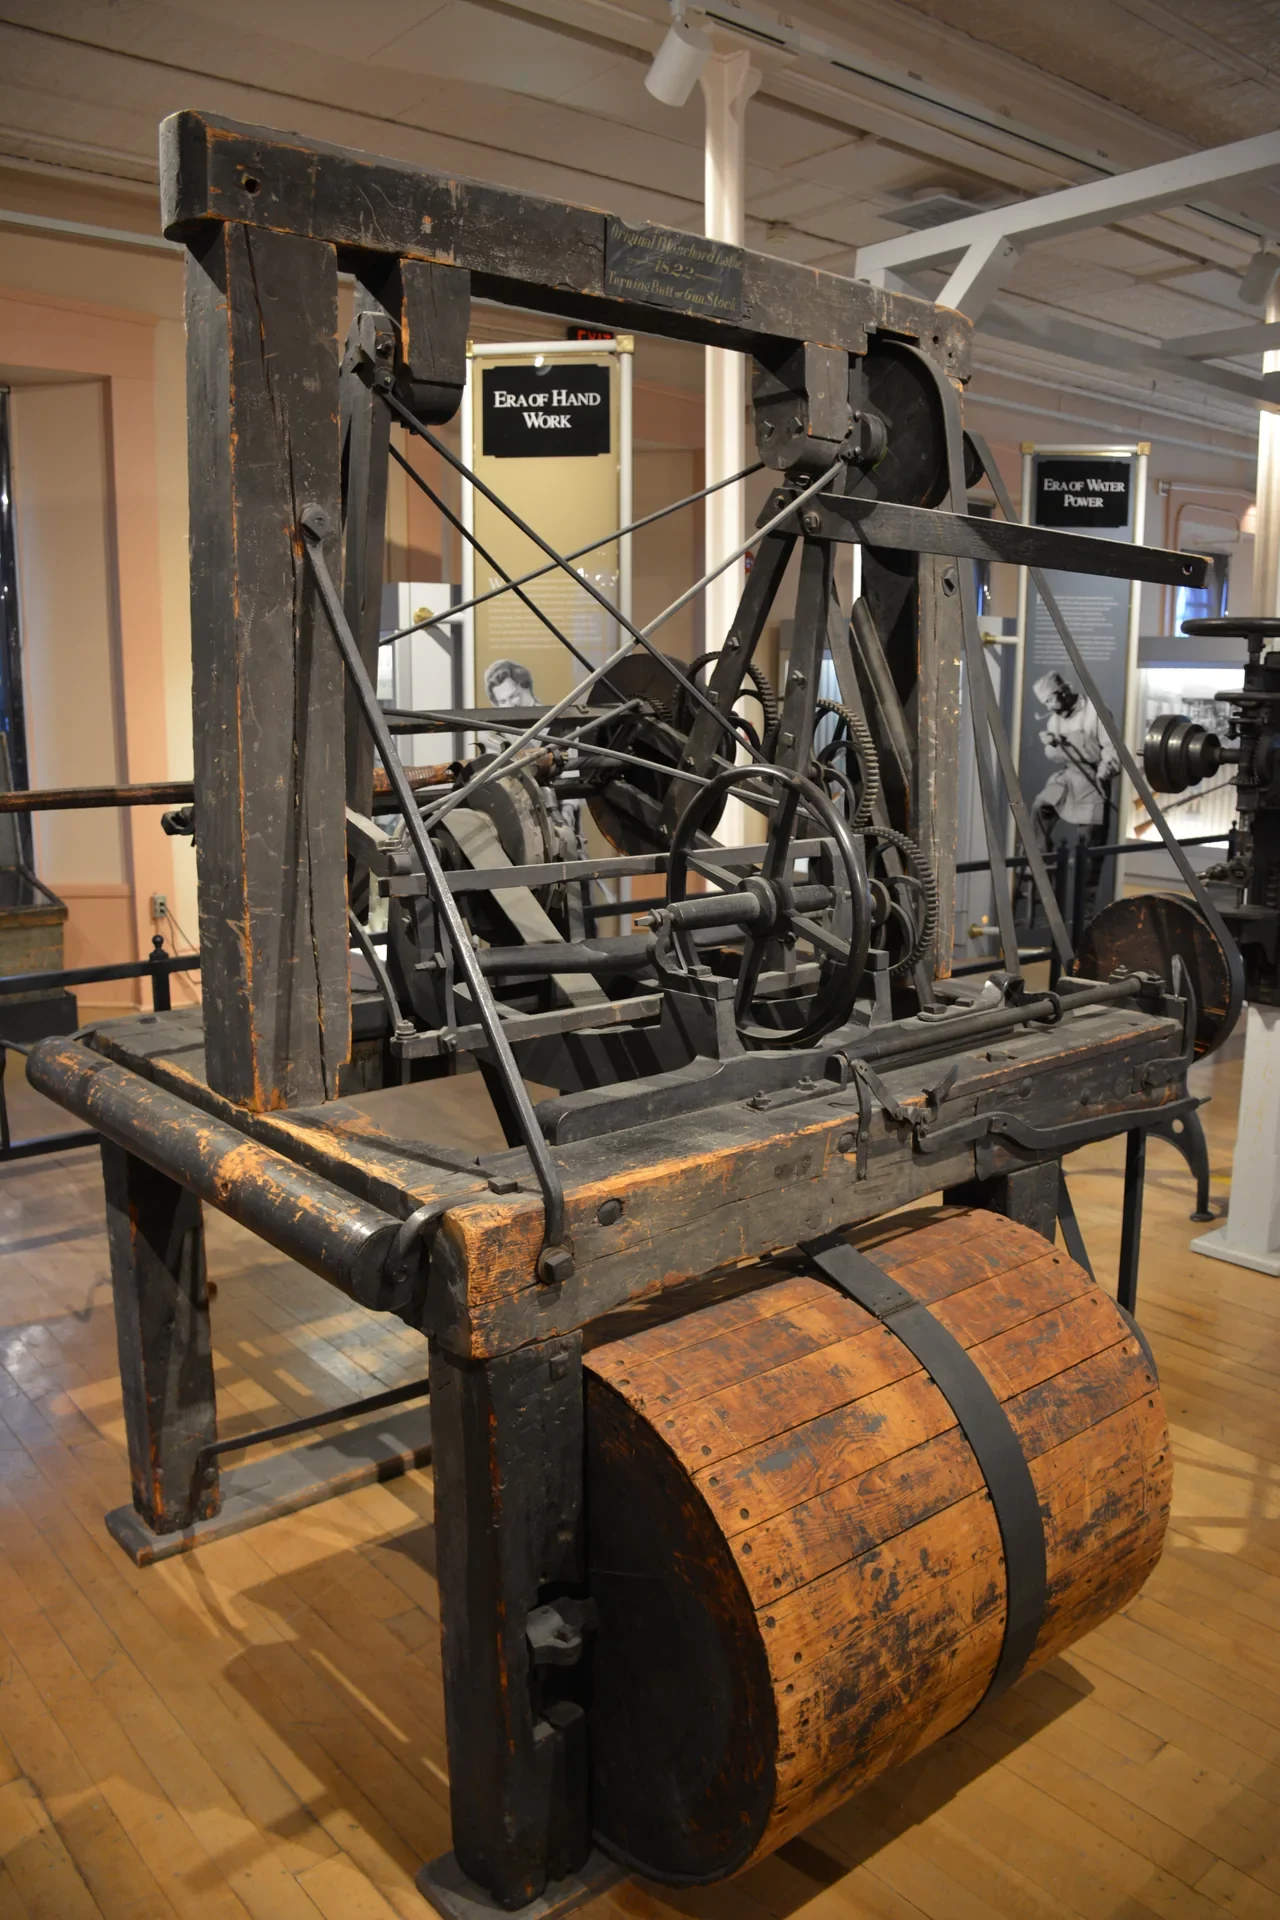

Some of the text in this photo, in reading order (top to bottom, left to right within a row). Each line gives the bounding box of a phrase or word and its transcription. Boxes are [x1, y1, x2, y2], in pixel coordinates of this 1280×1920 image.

[611, 223, 656, 249] Original
[657, 235, 715, 263] Blanchard
[608, 271, 650, 295] Turning
[684, 288, 704, 305] Gun
[705, 292, 738, 311] Stock
[493, 390, 601, 408] ERA OF HAND
[522, 412, 572, 429] WORK
[1043, 478, 1126, 492] ERA OF WATER
[1063, 494, 1104, 508] POWER
